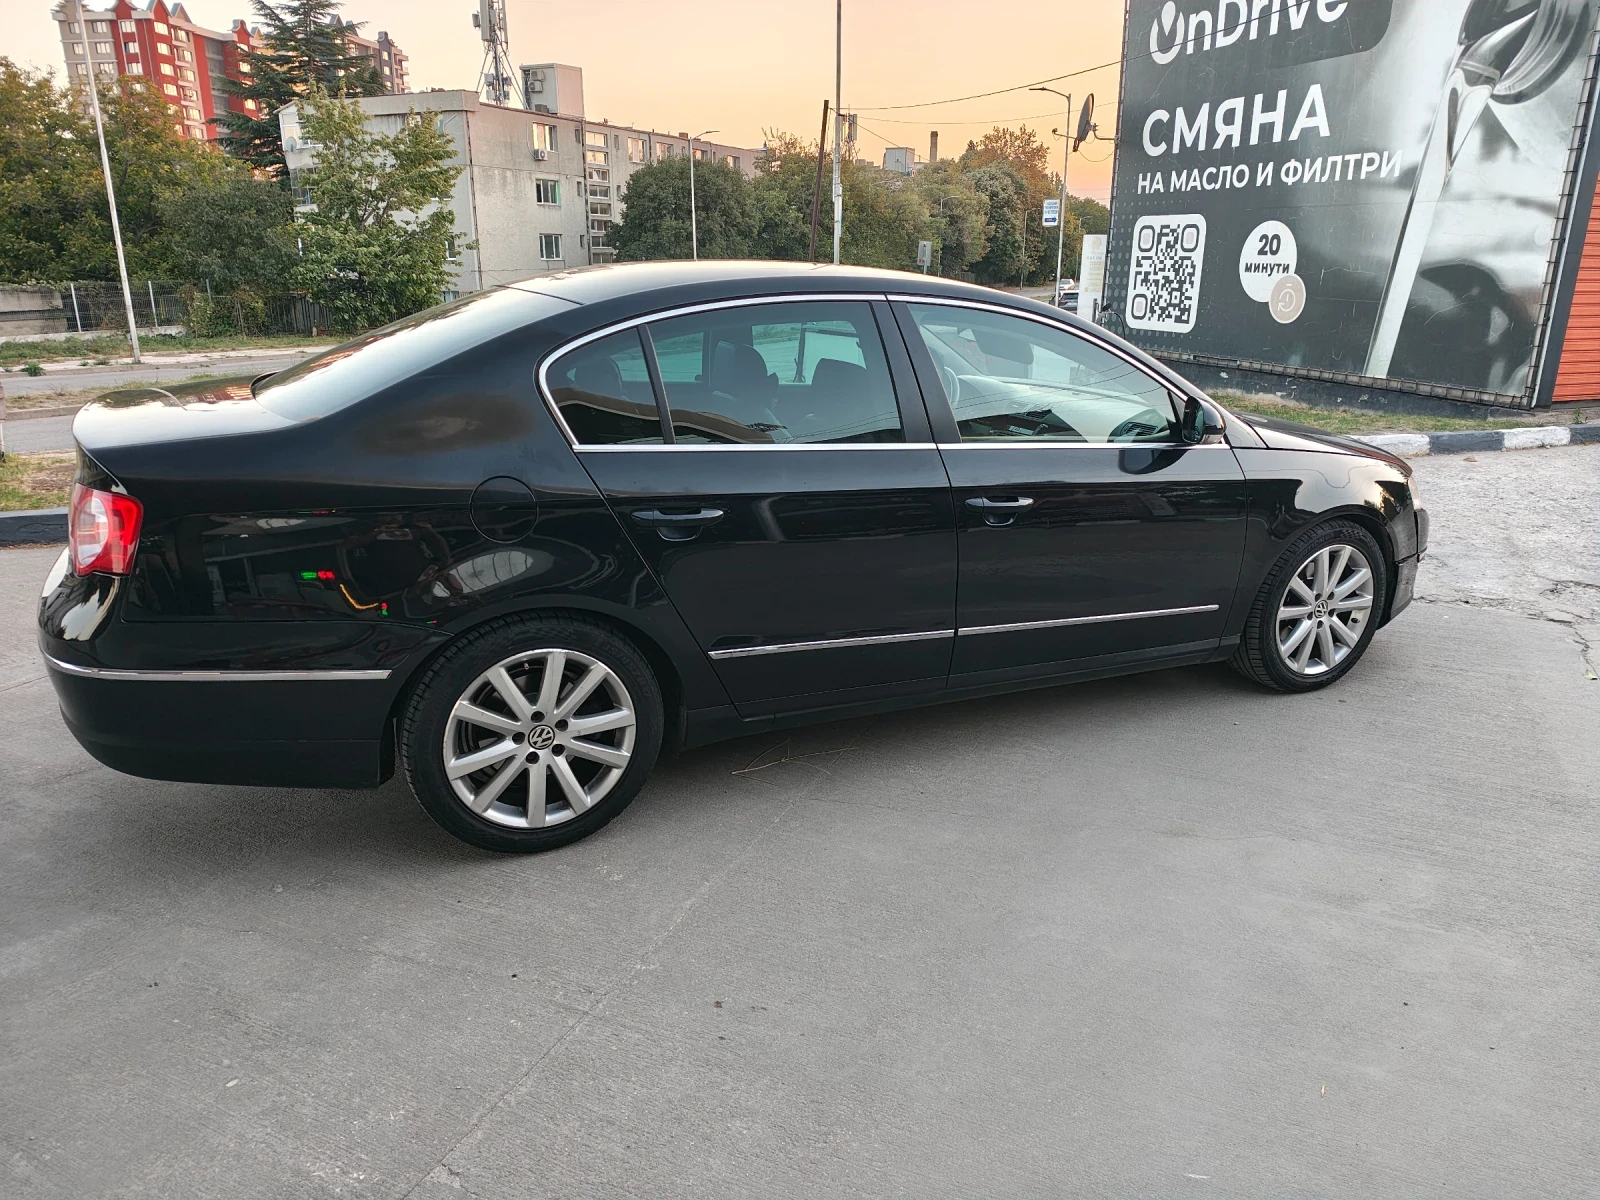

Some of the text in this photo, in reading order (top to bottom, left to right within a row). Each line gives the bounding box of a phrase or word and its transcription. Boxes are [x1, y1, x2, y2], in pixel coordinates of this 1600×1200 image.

[1142, 83, 1331, 157] СМЯНА
[1137, 149, 1404, 195] НА МАСЛО И ФИЛТРИ
[1257, 233, 1282, 256] 20
[1244, 262, 1290, 277] минути
